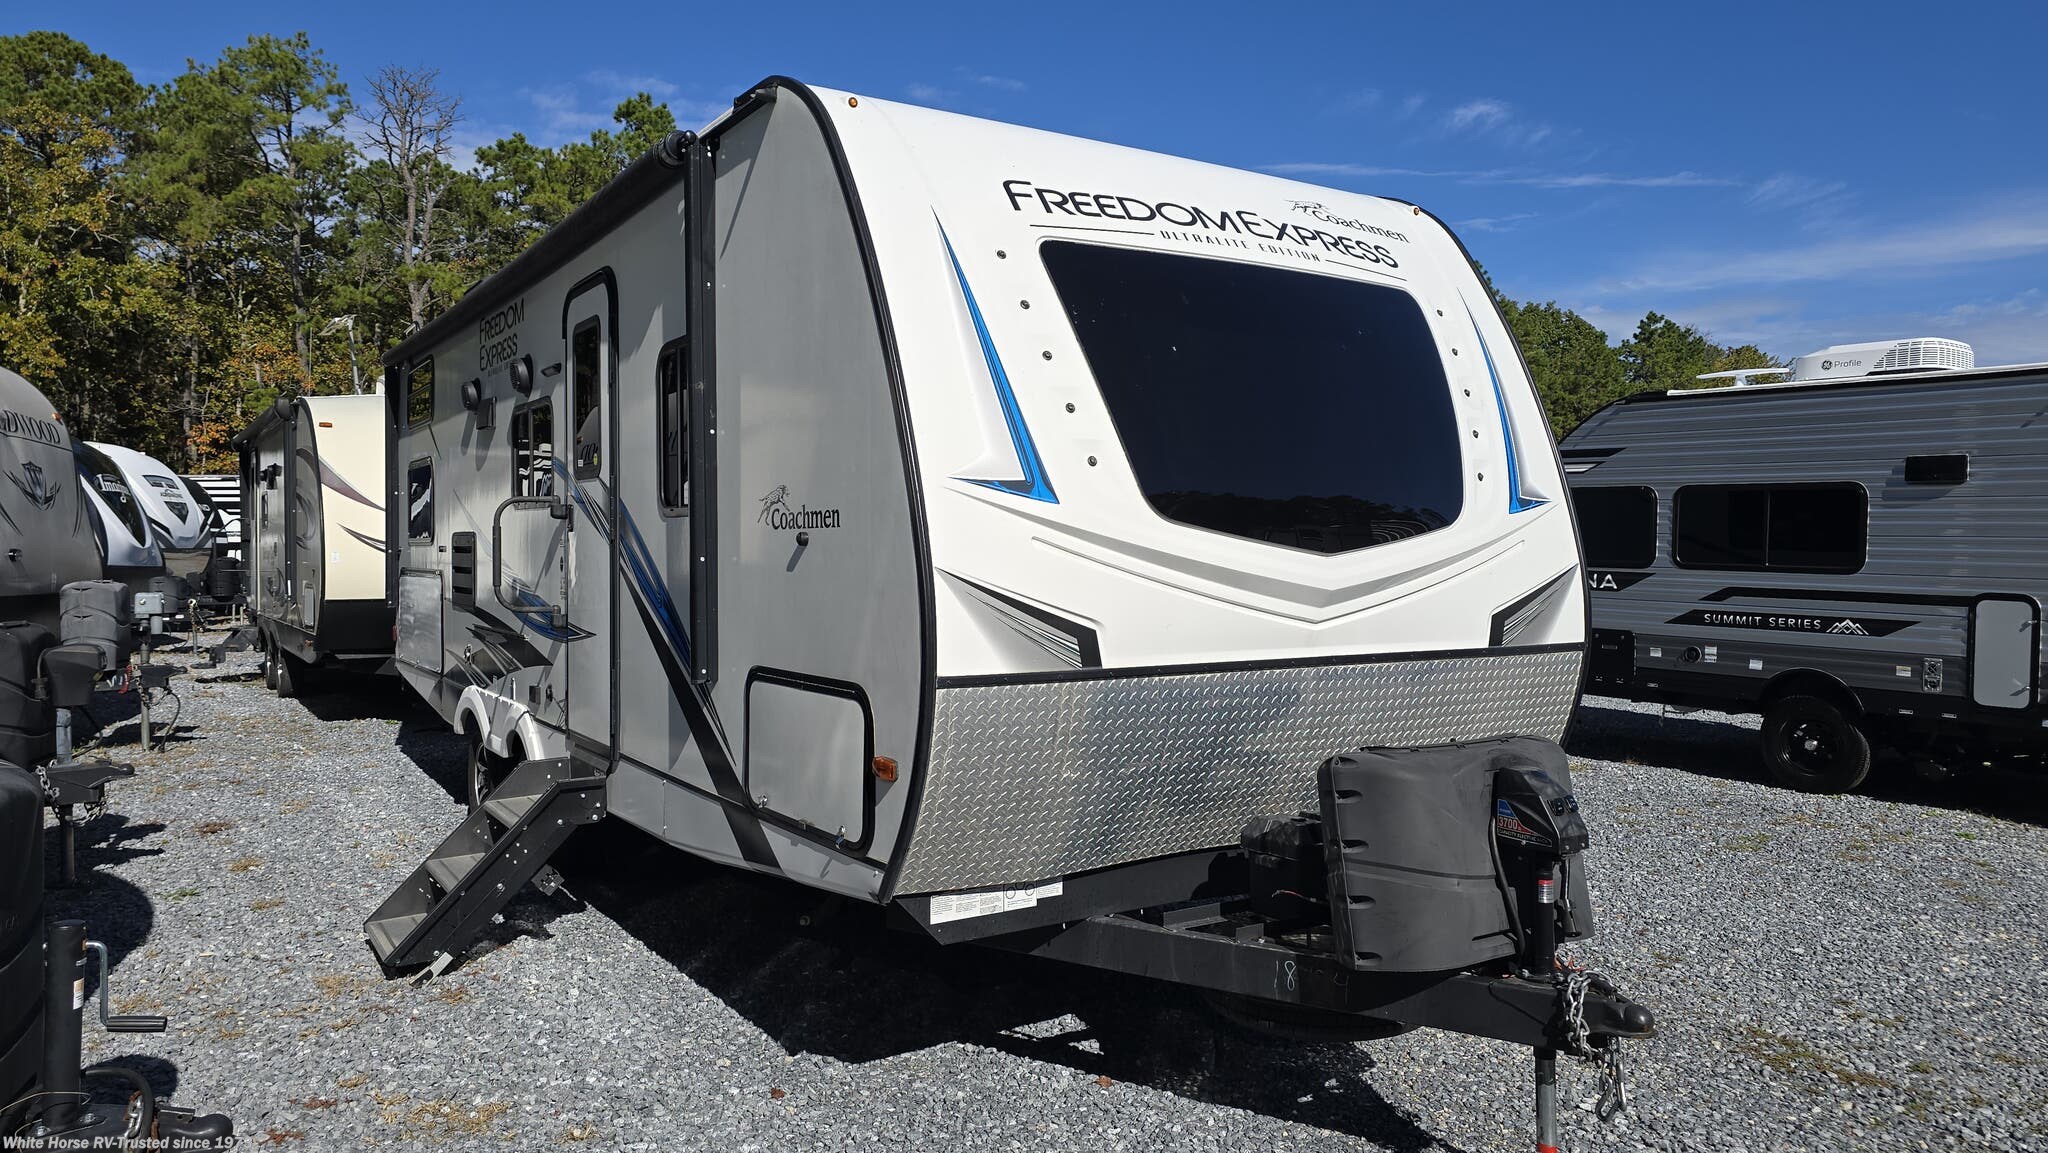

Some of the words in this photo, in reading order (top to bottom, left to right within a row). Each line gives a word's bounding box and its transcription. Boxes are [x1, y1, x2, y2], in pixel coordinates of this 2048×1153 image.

[1311, 209, 1410, 243] Coachmen
[1159, 229, 1251, 250] ULTRALITE
[1258, 242, 1321, 262] EDITION
[479, 297, 525, 345] FREEDOM
[479, 332, 518, 372] EXPRESS
[1833, 359, 1862, 368] Profile
[771, 504, 841, 530] Coachmen
[1703, 613, 1763, 627] SUMMIT
[1768, 617, 1822, 630] SERIES
[1499, 817, 1518, 830] 3700
